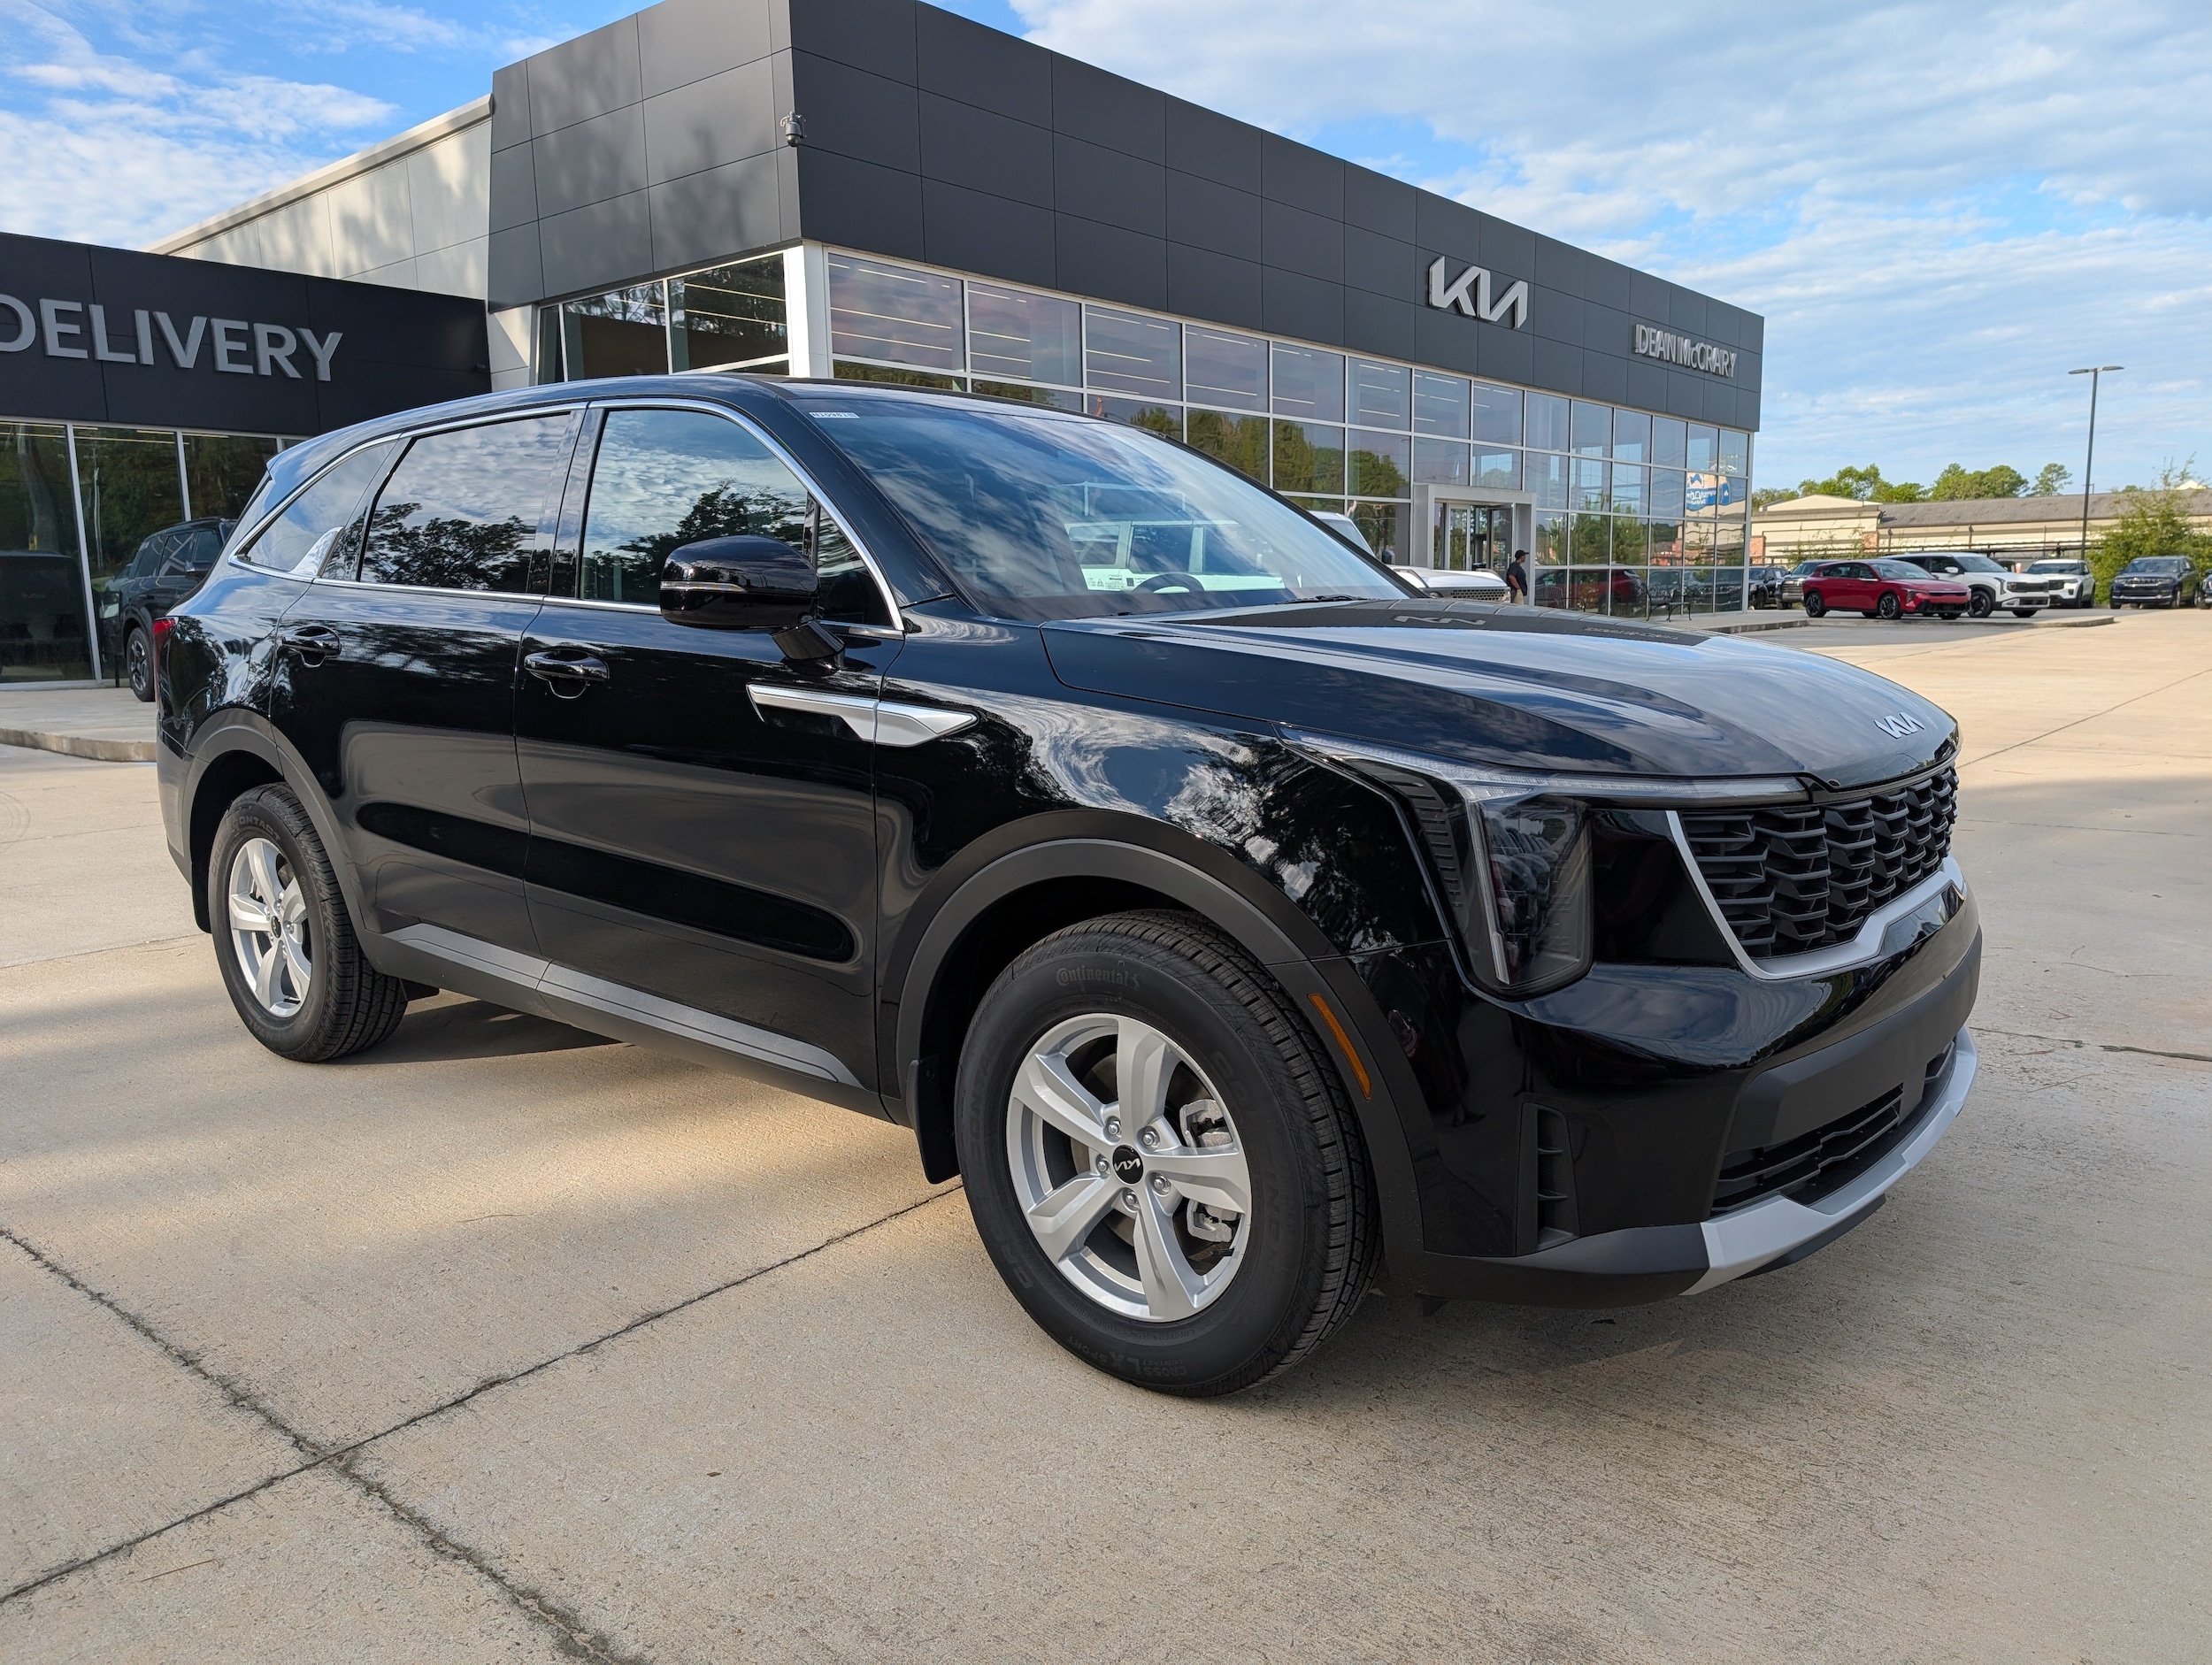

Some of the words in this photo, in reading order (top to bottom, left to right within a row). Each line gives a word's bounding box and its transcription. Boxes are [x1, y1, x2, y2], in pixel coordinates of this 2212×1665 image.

[1428, 255, 1528, 329] KIA
[0, 294, 343, 381] DELIVERY
[1634, 324, 1677, 363] DEAN
[1873, 711, 1925, 739] KIA
[1056, 965, 1130, 986] Continental
